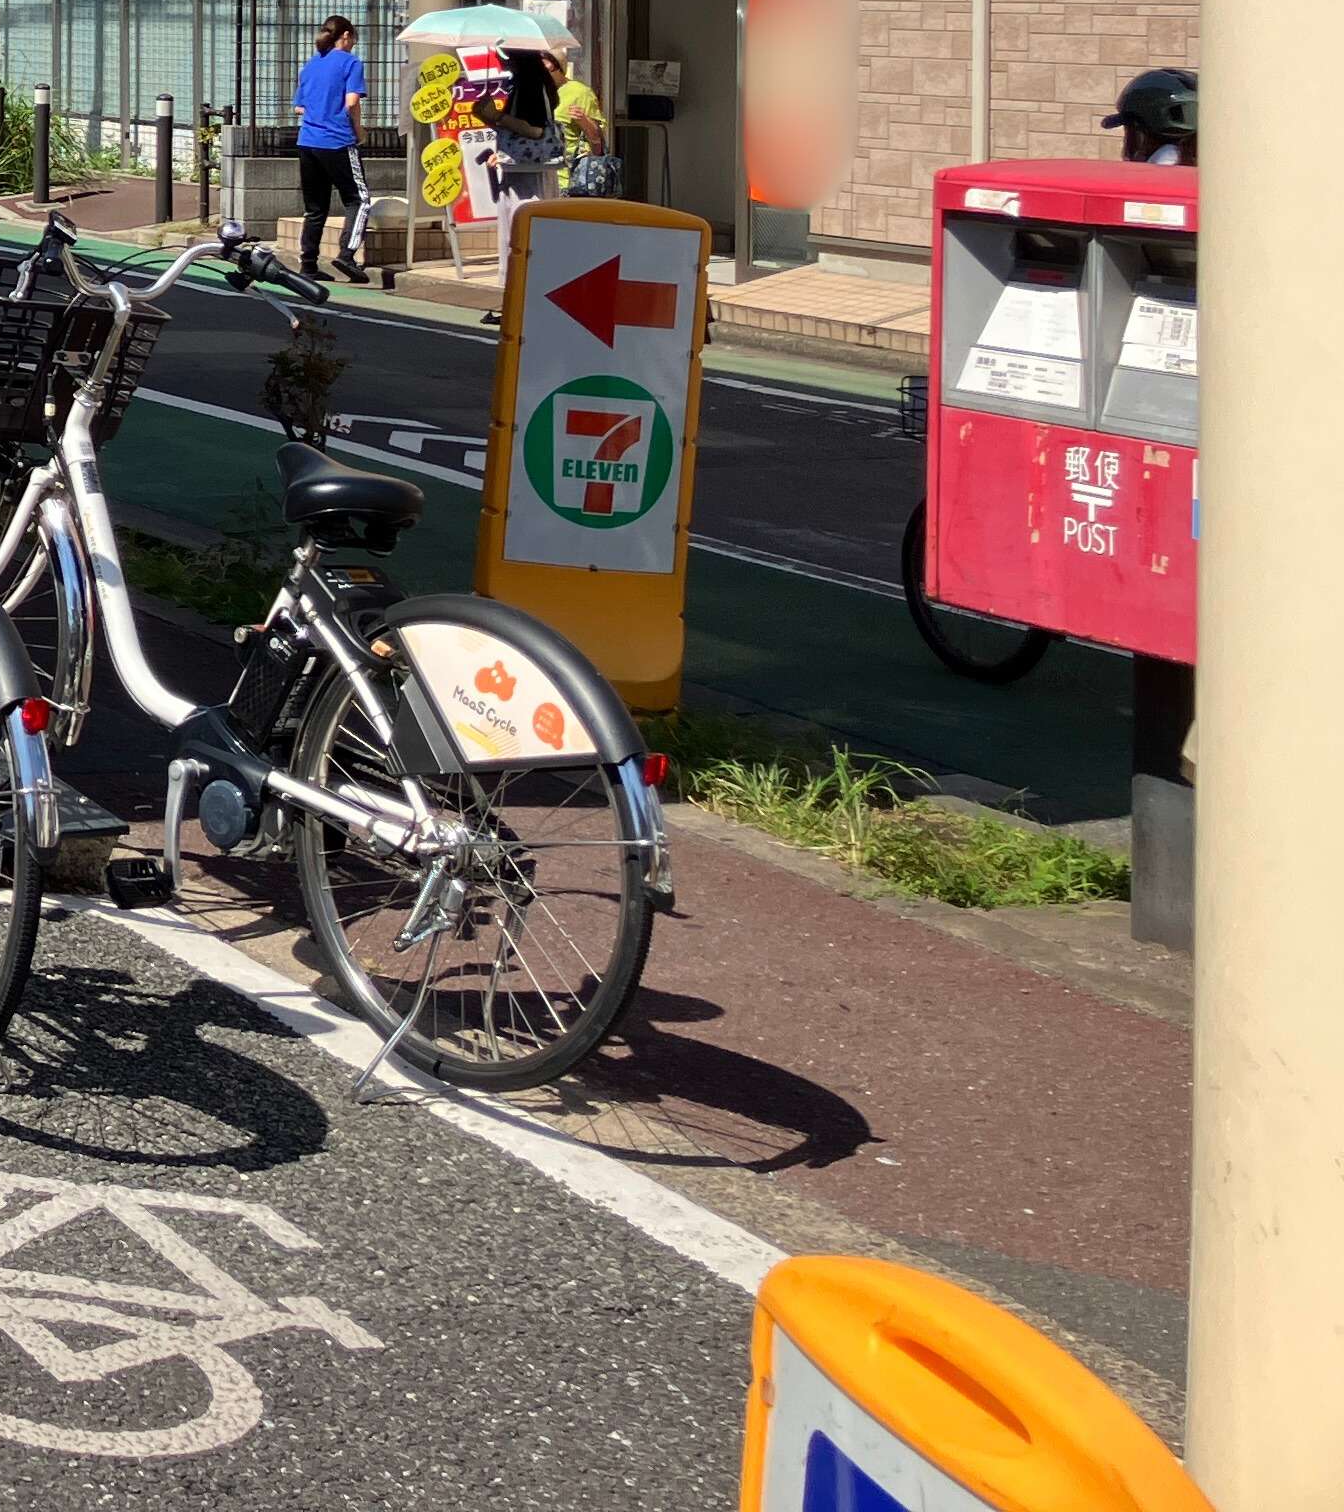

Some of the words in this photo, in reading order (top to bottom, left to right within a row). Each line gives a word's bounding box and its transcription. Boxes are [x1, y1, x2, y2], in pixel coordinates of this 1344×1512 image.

[1065, 445, 1121, 491] 郵便
[1063, 521, 1119, 557] POST
[452, 684, 487, 716] MaaS
[485, 707, 517, 737] Cycle
